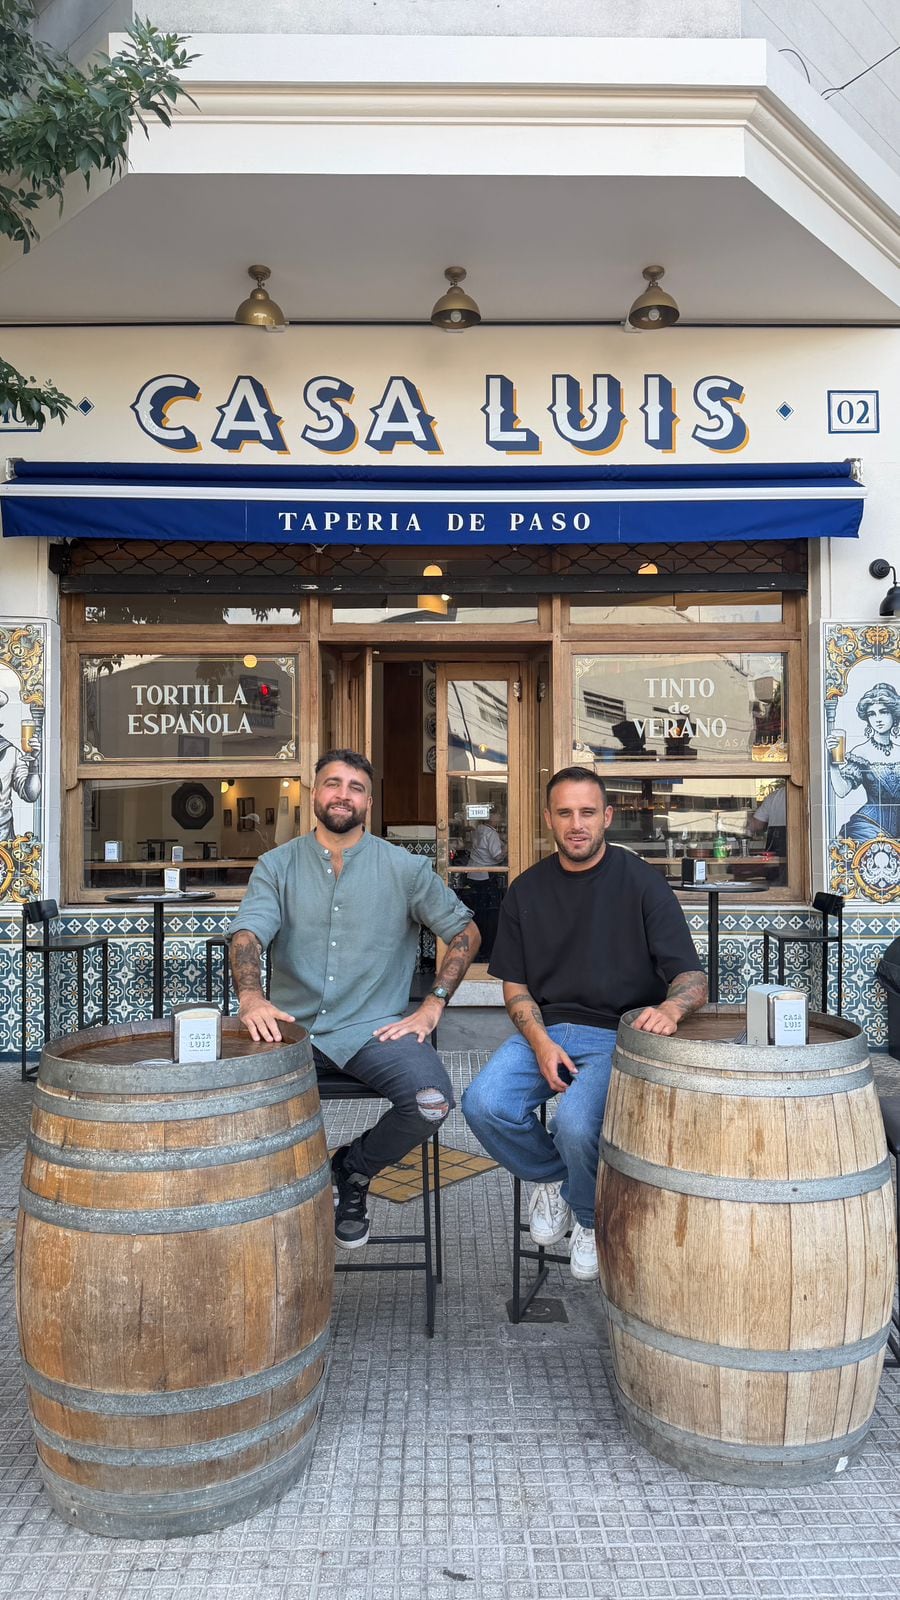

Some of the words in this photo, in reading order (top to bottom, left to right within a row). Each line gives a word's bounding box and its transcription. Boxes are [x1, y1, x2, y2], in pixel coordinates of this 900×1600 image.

[130, 374, 445, 455] CASA
[480, 374, 750, 456] LUIS
[837, 400, 869, 424] 02
[278, 511, 422, 532] TAPERIA
[447, 513, 486, 532] DE
[509, 511, 591, 532] PASO
[131, 683, 248, 706] TORTILLA
[644, 677, 715, 698] TINTO
[667, 701, 691, 715] de
[127, 709, 253, 735] ESPAÑOLA
[633, 717, 728, 738] VERANO
